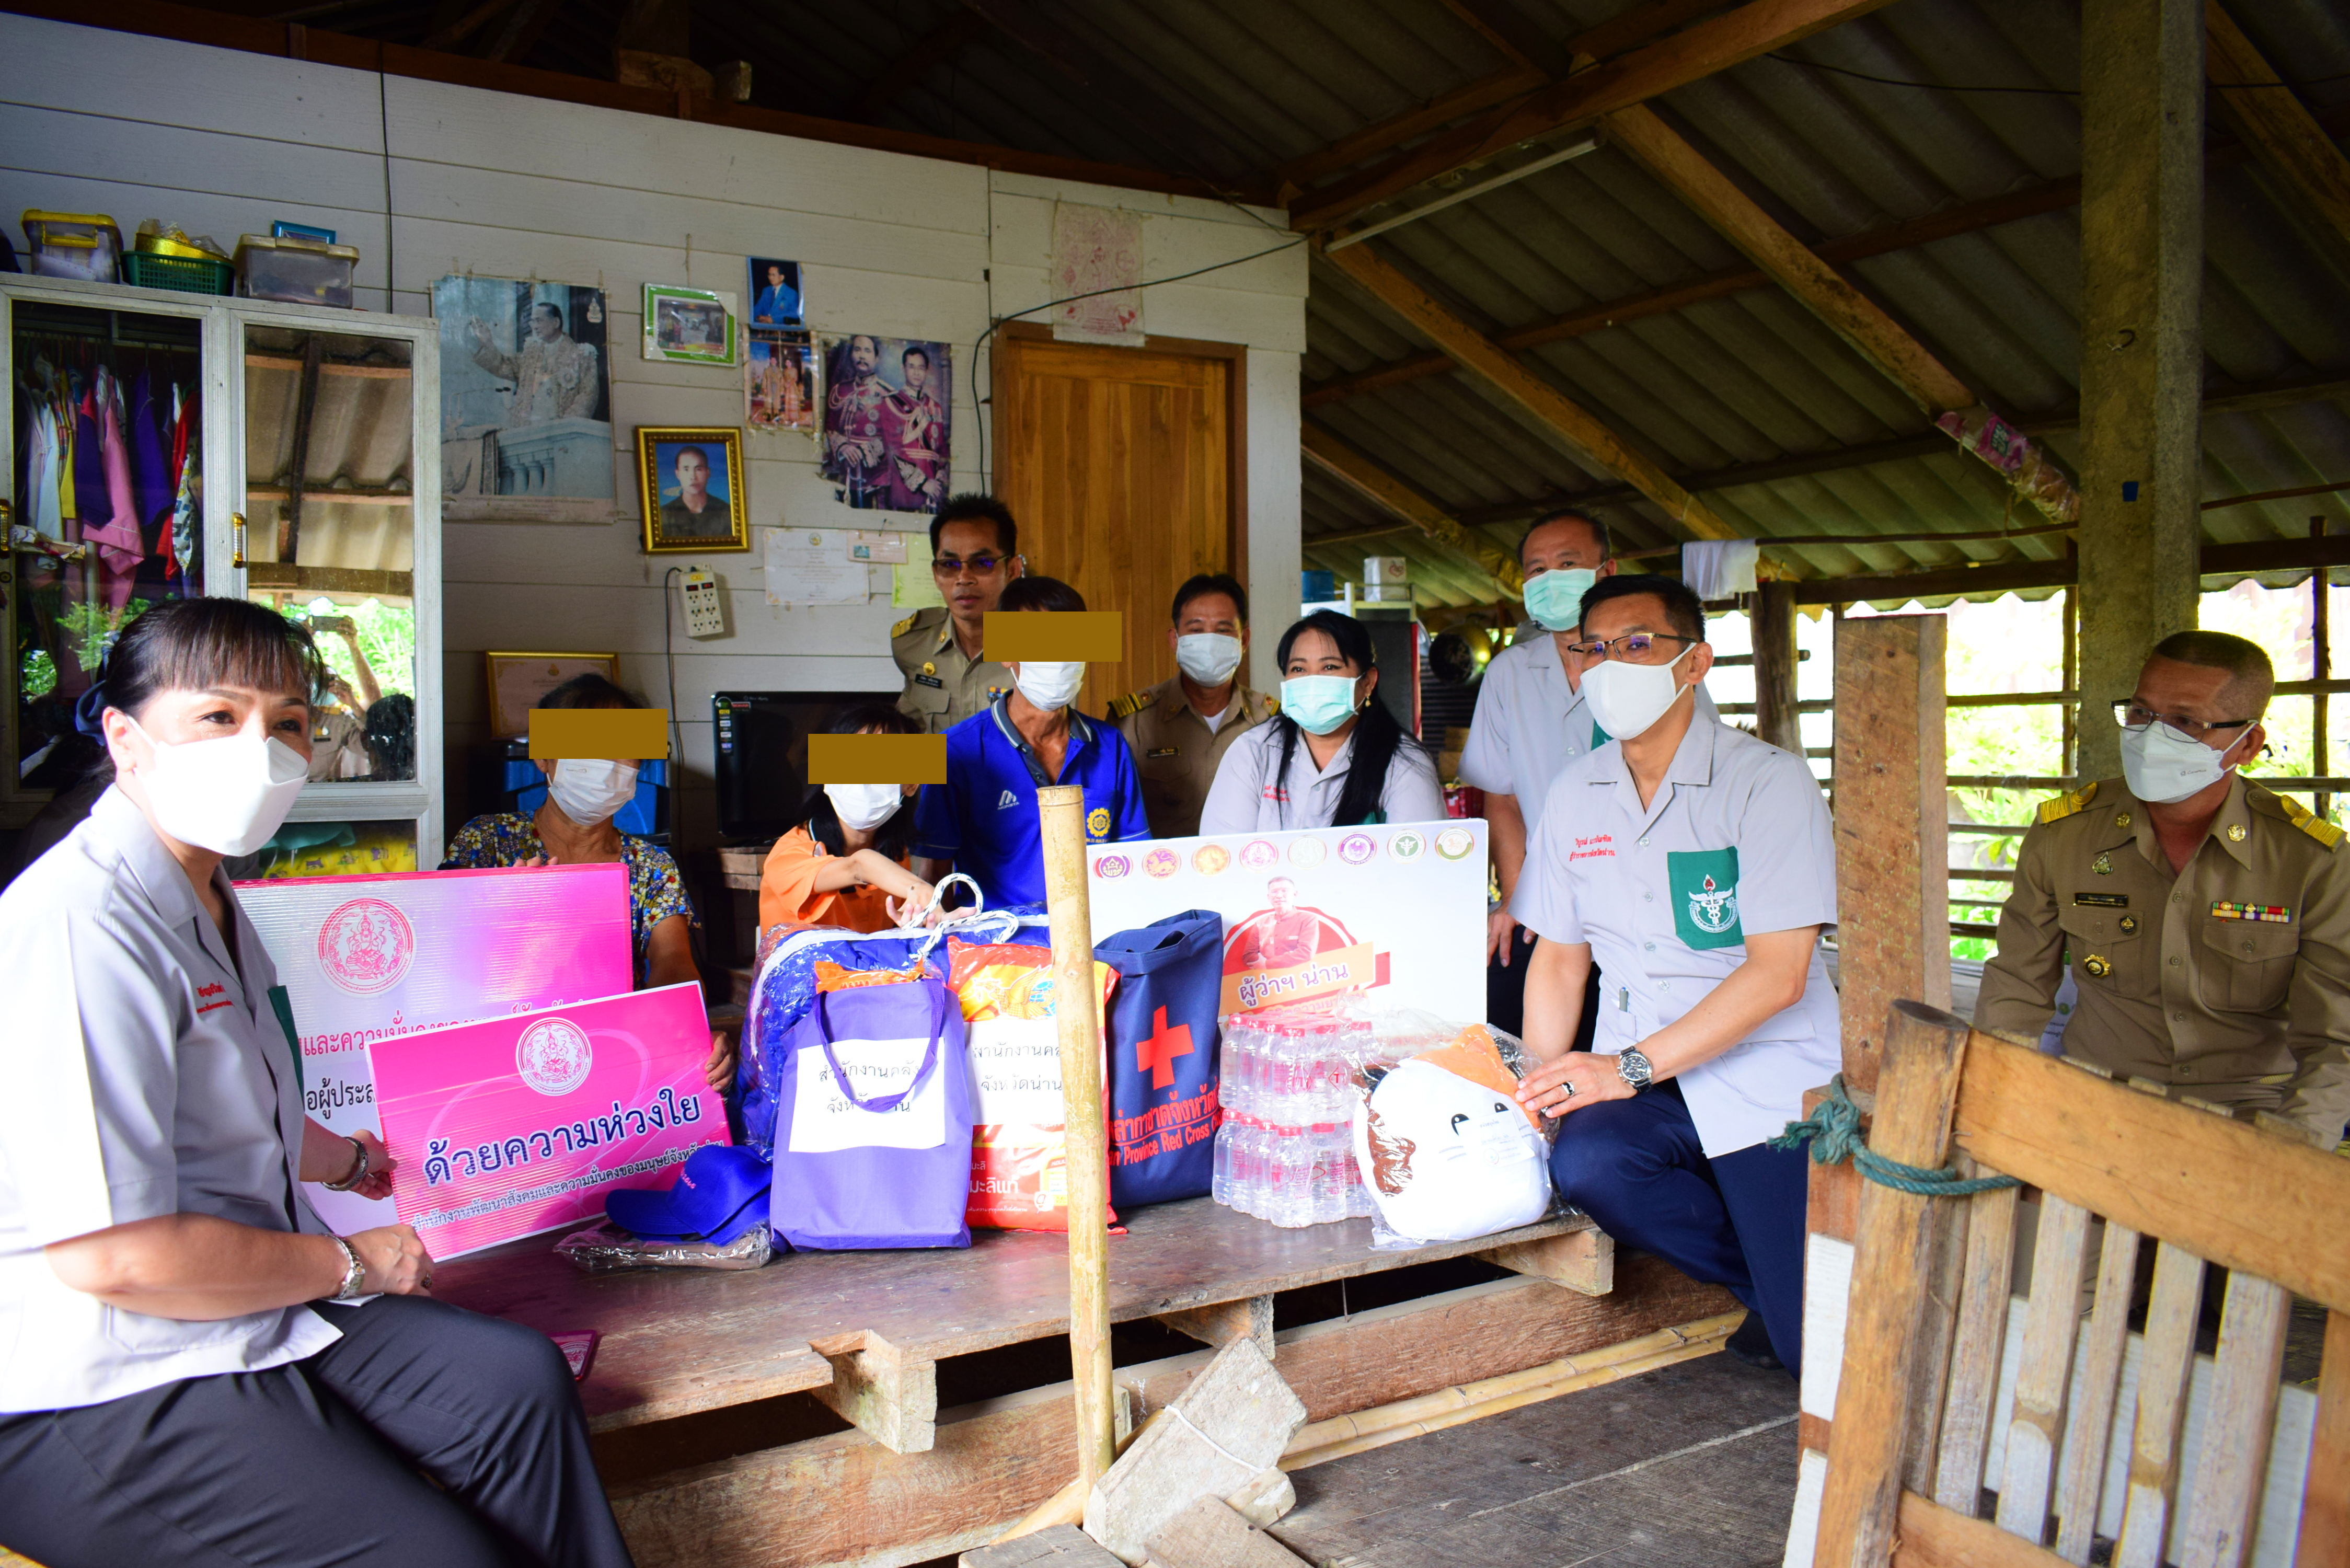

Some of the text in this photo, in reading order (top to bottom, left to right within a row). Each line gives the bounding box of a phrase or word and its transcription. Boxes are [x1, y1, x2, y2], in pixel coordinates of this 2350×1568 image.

[1239, 975, 1295, 1007] ผู้ว่าฯ
[1302, 964, 1349, 986] น่าน
[424, 1087, 699, 1185] ด้วยความห่วงใย
[1124, 1140, 1159, 1166] Province
[1160, 1129, 1182, 1152] Red
[1185, 1123, 1209, 1145] Cross
